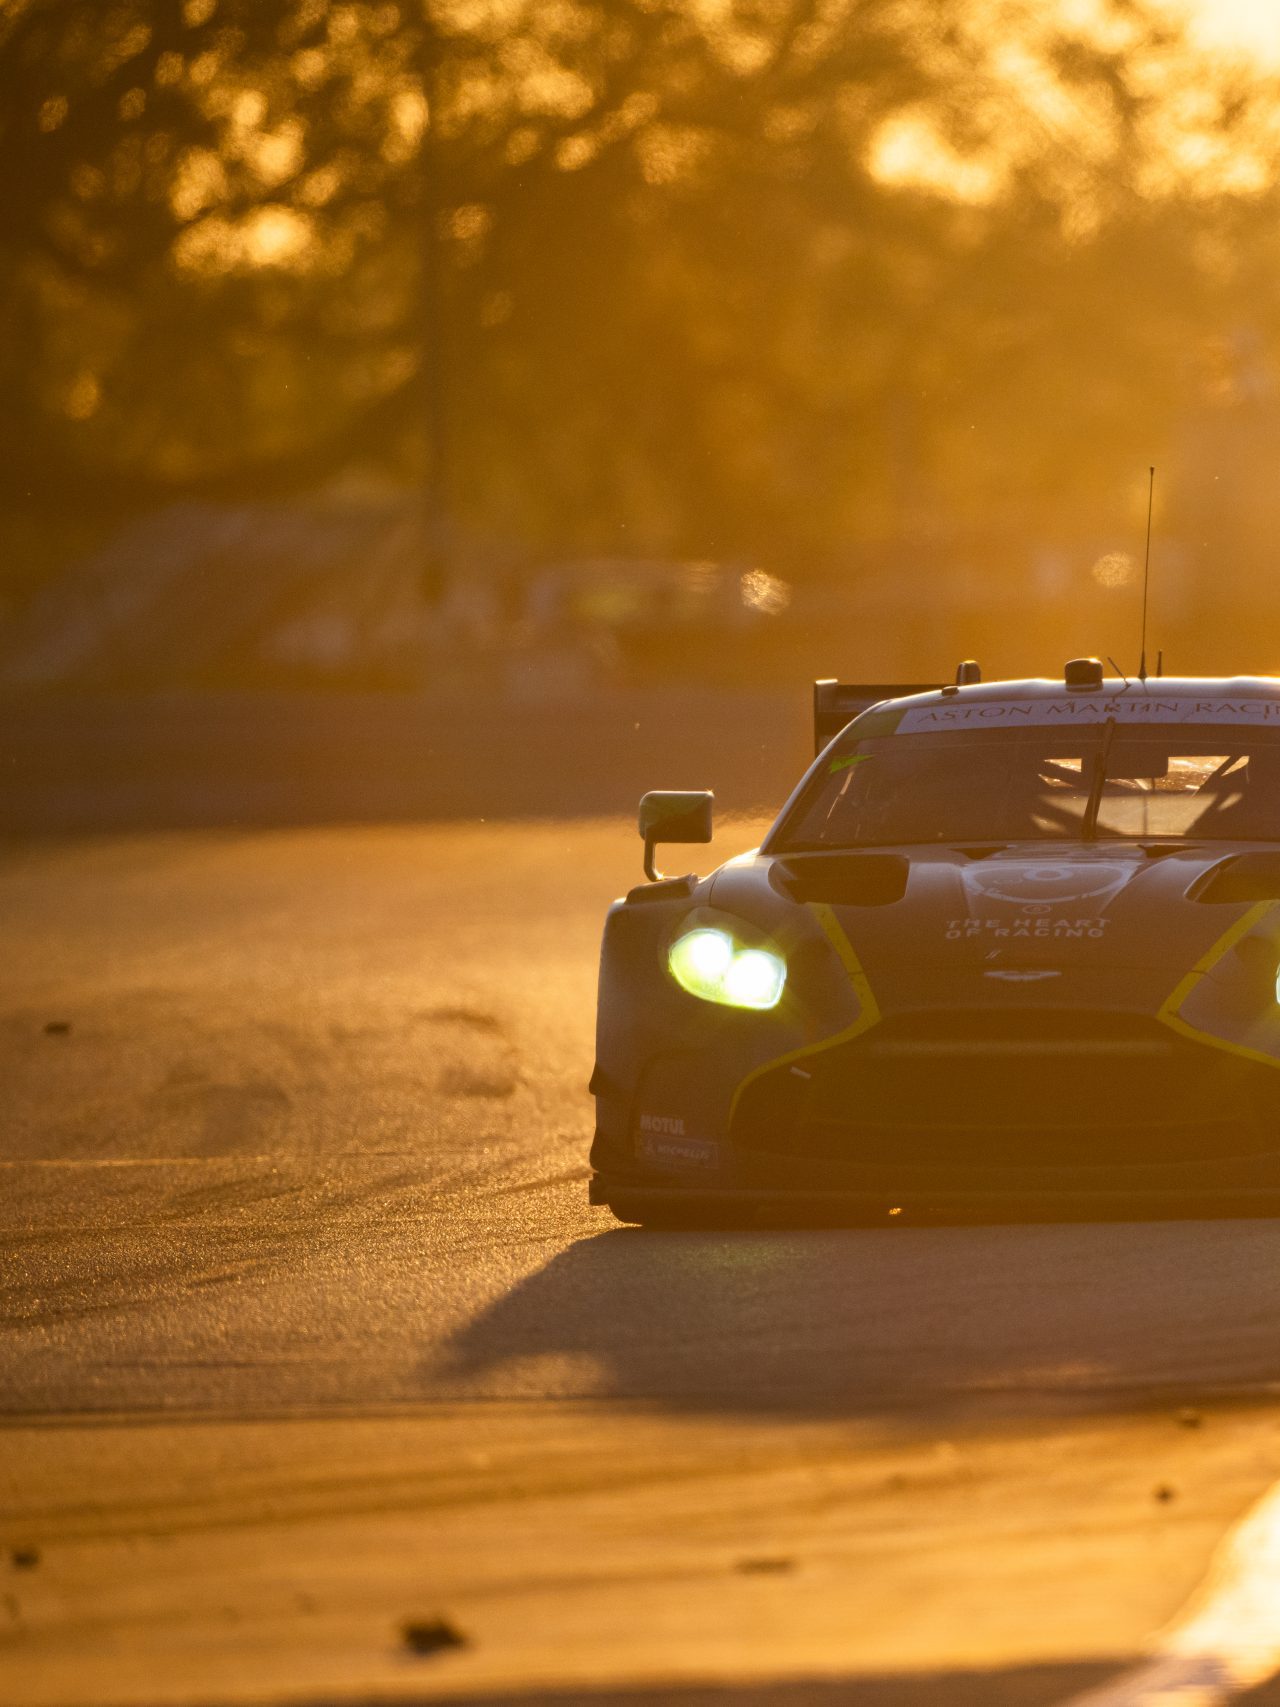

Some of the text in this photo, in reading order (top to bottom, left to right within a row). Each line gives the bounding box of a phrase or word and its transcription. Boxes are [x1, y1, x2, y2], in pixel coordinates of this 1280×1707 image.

[917, 705, 1033, 723] ASTON
[1046, 701, 1178, 715] MARTIN
[945, 918, 1111, 929] THE HEART
[945, 928, 1104, 940] OF RACING
[639, 1114, 686, 1136] MOTUL
